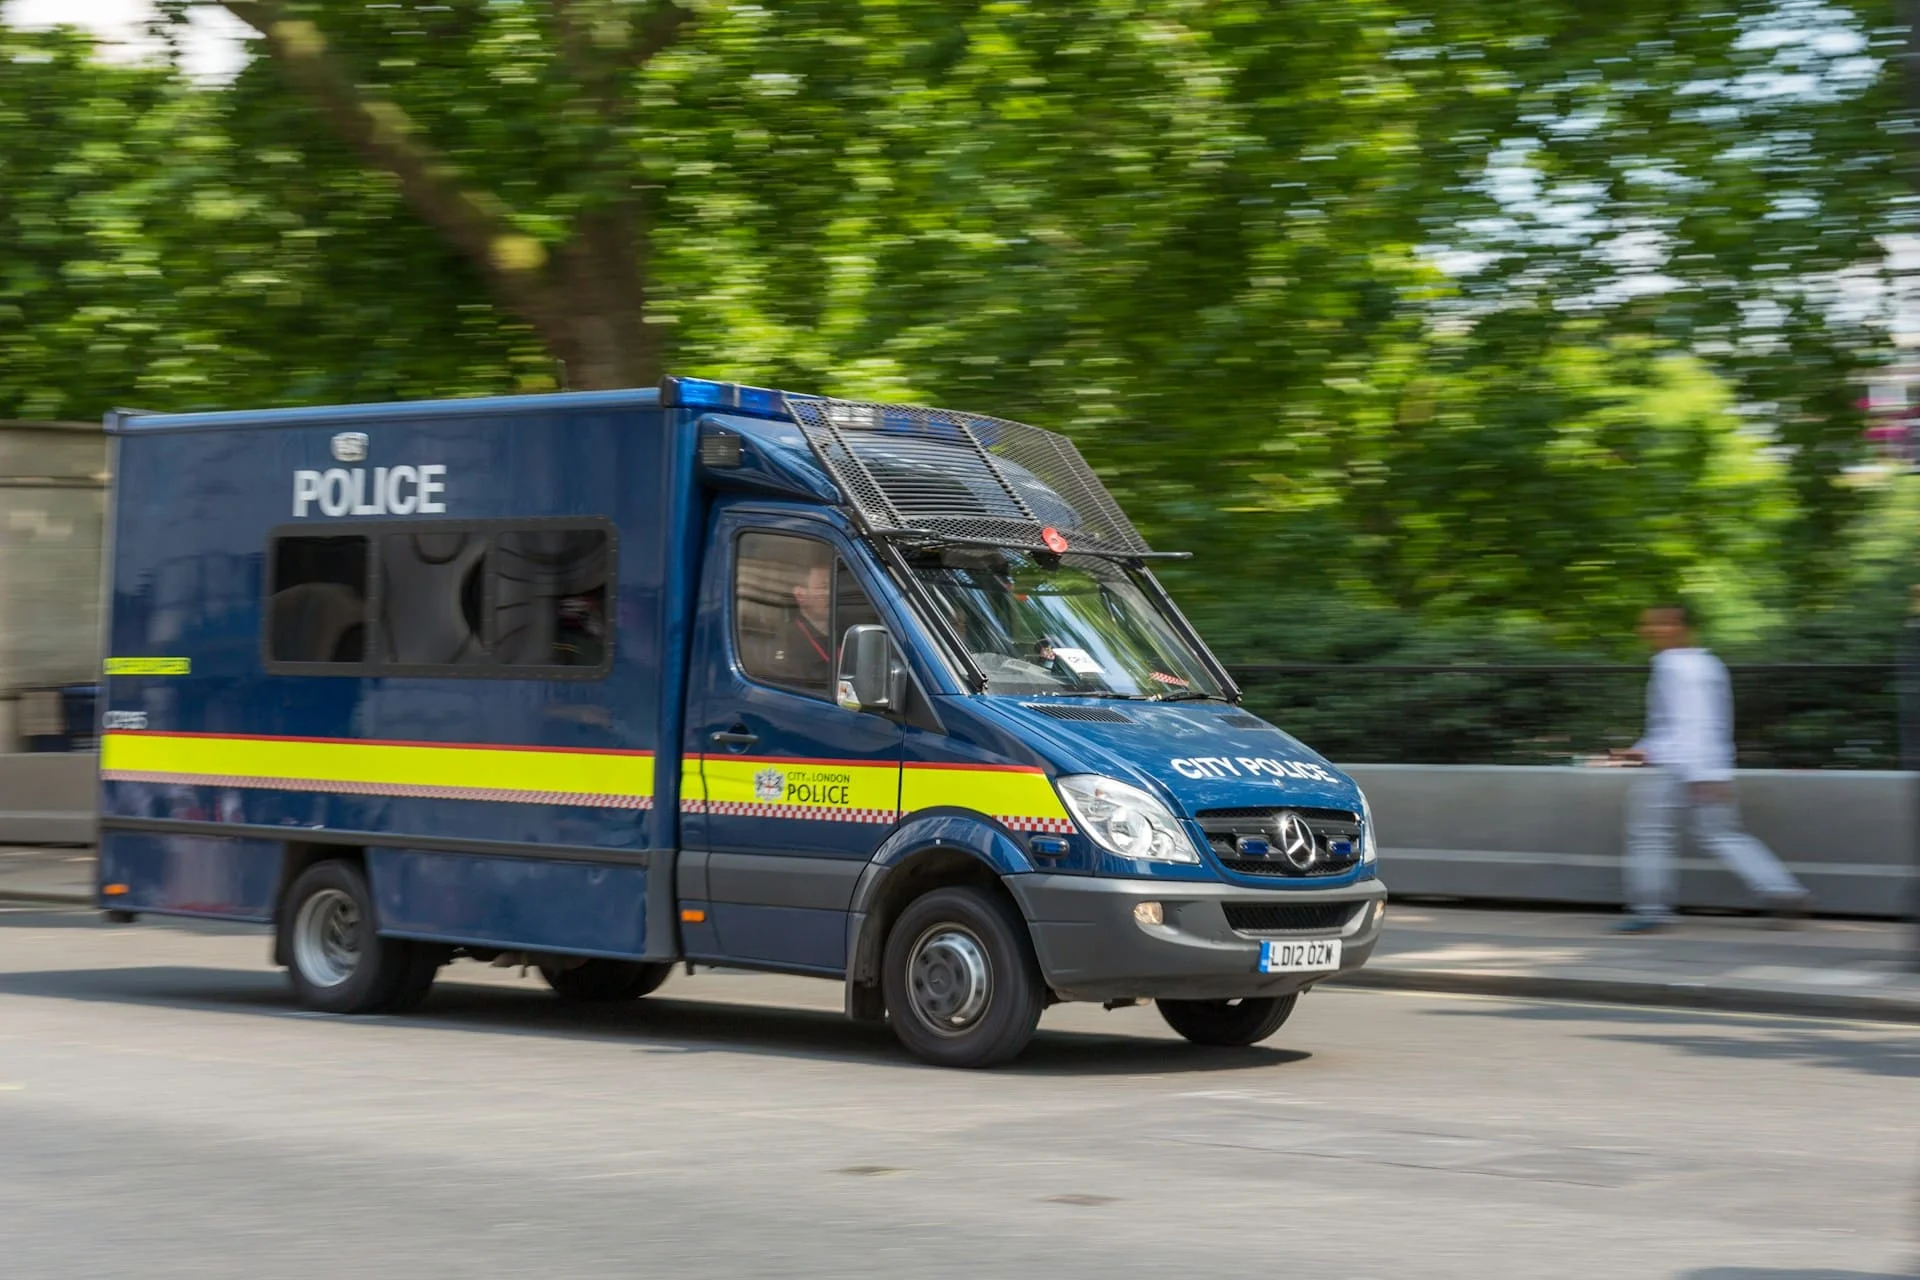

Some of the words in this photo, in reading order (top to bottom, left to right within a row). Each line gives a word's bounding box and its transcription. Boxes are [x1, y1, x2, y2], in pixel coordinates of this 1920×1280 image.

[292, 464, 447, 517] POLICE
[787, 771, 807, 781] CITY
[812, 772, 850, 783] LONDON
[1170, 757, 1242, 780] CITY
[1235, 757, 1339, 784] POLICE
[786, 783, 849, 804] POLICE
[1272, 945, 1304, 966] LD12
